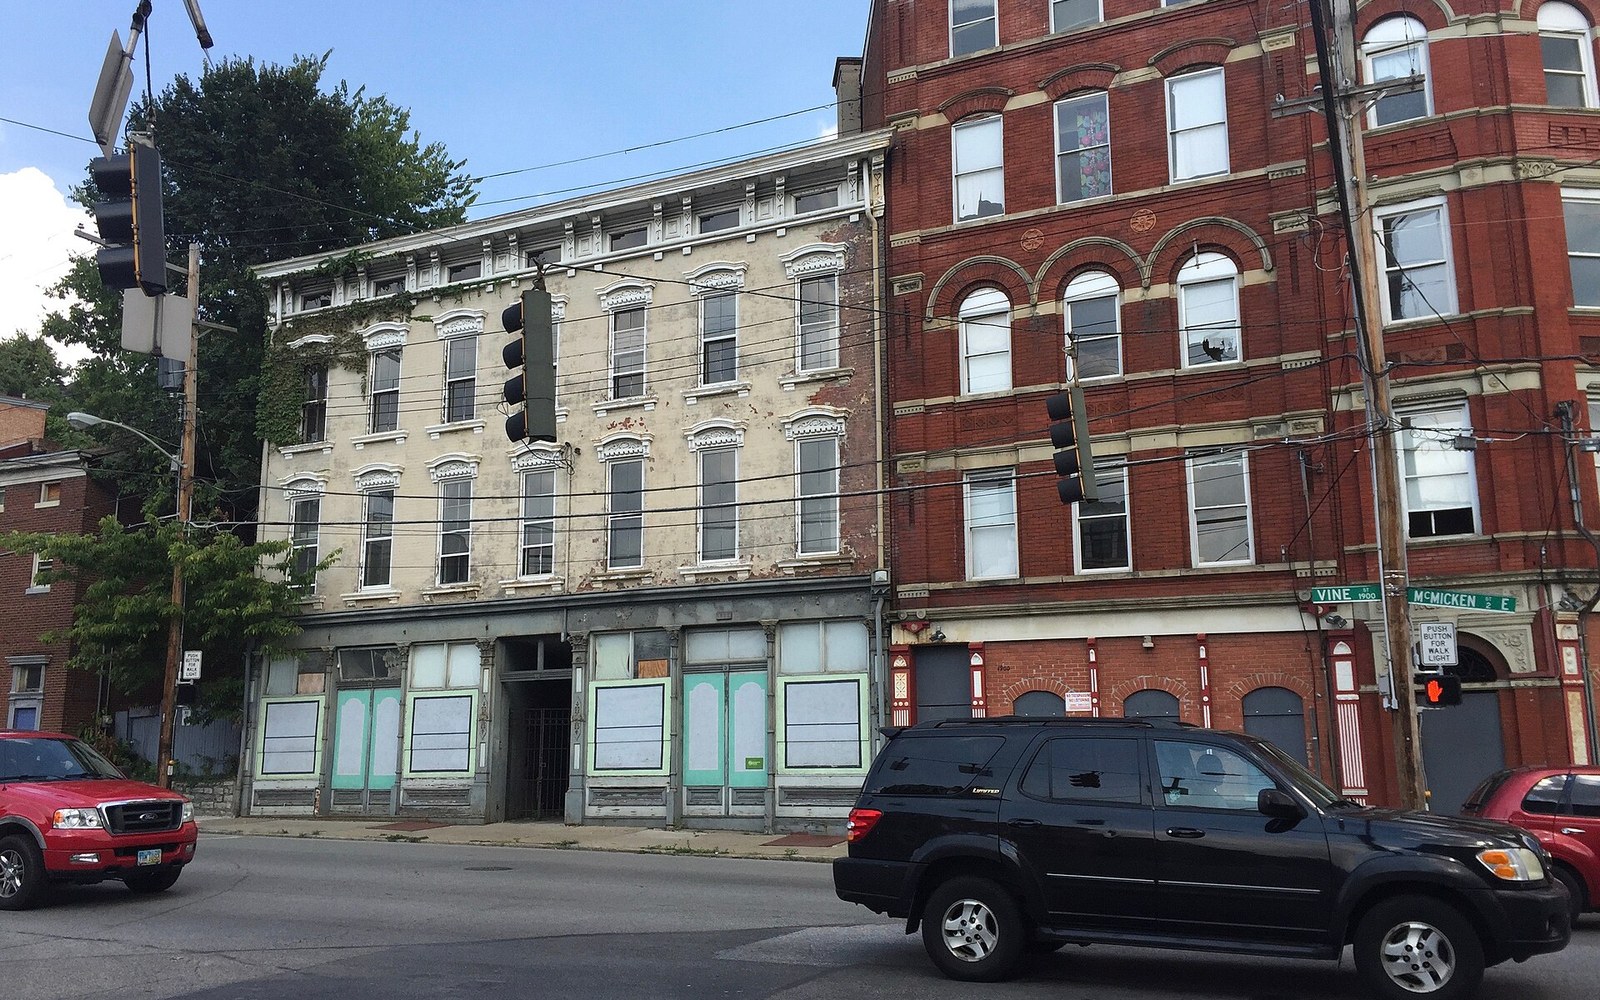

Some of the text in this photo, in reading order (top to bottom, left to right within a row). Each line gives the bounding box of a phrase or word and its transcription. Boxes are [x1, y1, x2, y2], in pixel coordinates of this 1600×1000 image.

[1317, 588, 1352, 601] VINE
[1358, 592, 1377, 600] 1900
[1501, 598, 1510, 611] E
[1427, 625, 1448, 633] PUSH
[1423, 632, 1452, 640] BUTTON
[1428, 647, 1450, 655] WALK
[1428, 654, 1451, 662] LIGHT
